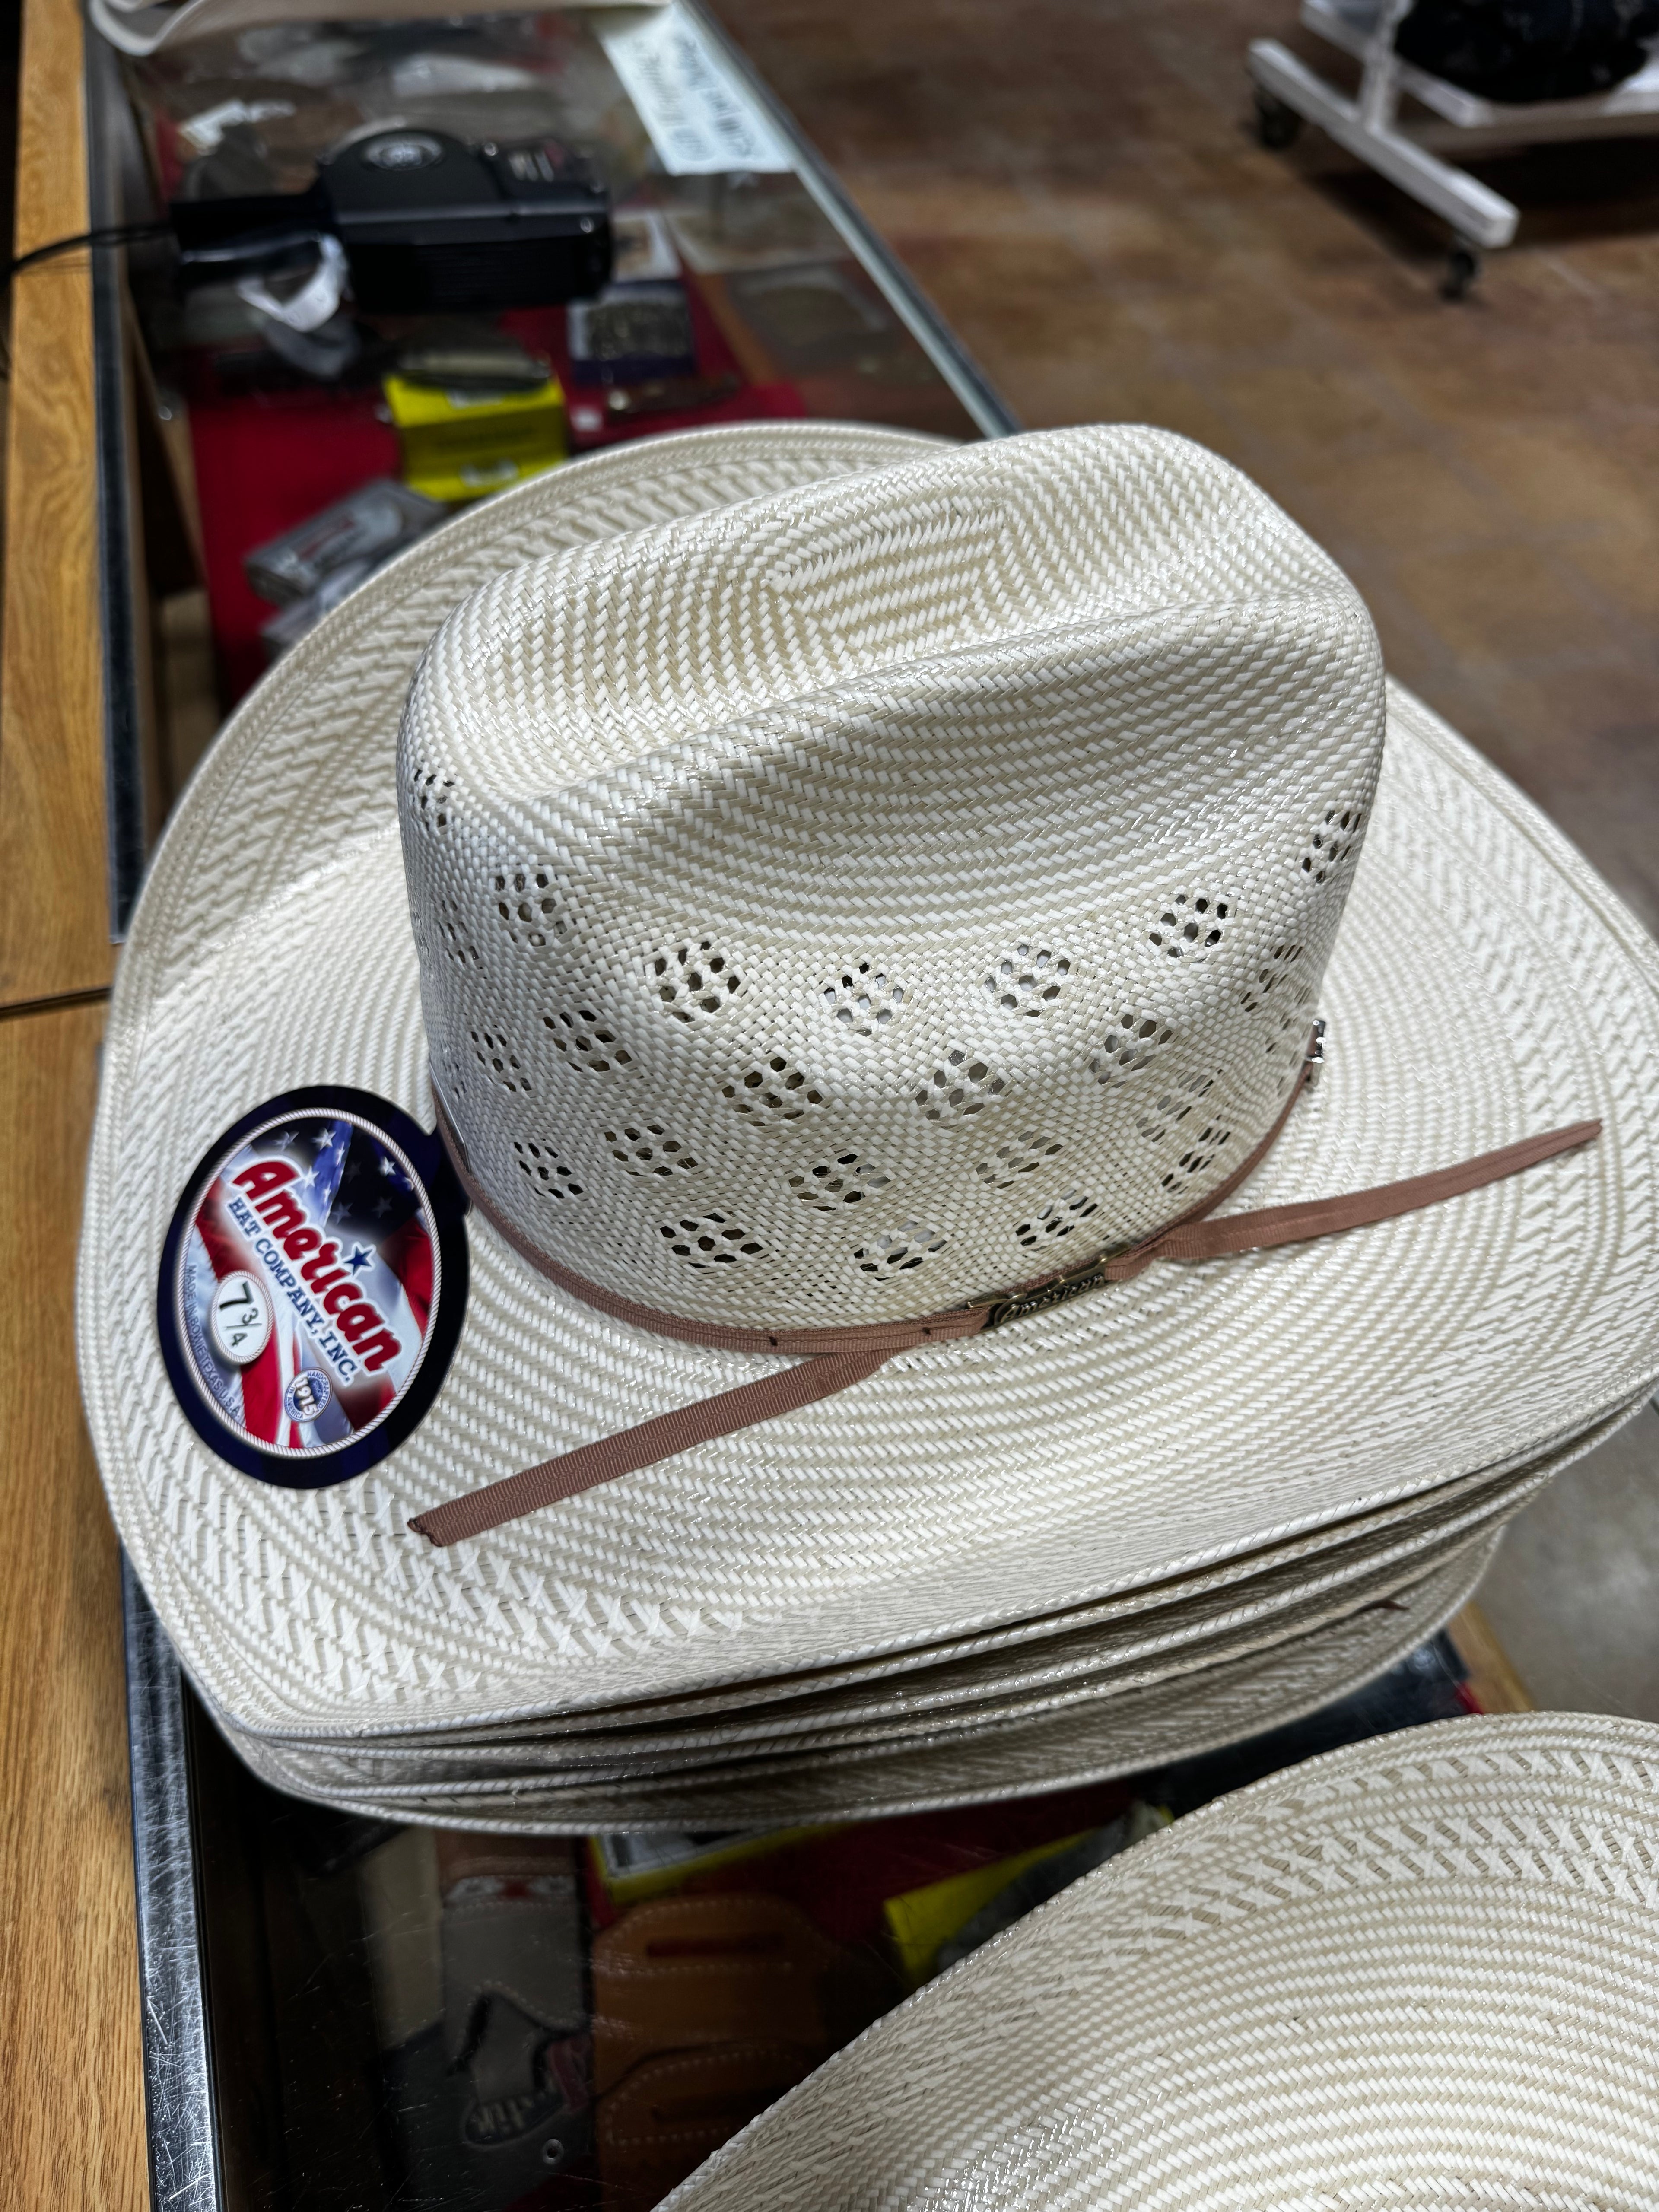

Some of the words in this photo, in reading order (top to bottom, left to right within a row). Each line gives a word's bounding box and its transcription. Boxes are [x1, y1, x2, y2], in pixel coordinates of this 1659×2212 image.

[185, 1265, 196, 1300] MADE
[232, 1161, 402, 1371] American
[187, 1300, 197, 1317] IN
[219, 1281, 254, 1311] 7
[229, 1197, 262, 1236] HAT
[256, 1239, 324, 1334] COMPANY,
[320, 1332, 357, 1382] INC.
[189, 1317, 207, 1356] BOWIE
[199, 1354, 223, 1392] TEXAS
[307, 1371, 330, 1410] HANDCRAFTED
[218, 1389, 241, 1418] U.S.A.
[287, 1396, 303, 1419] AMERICA
[296, 1377, 318, 1415] 1915
